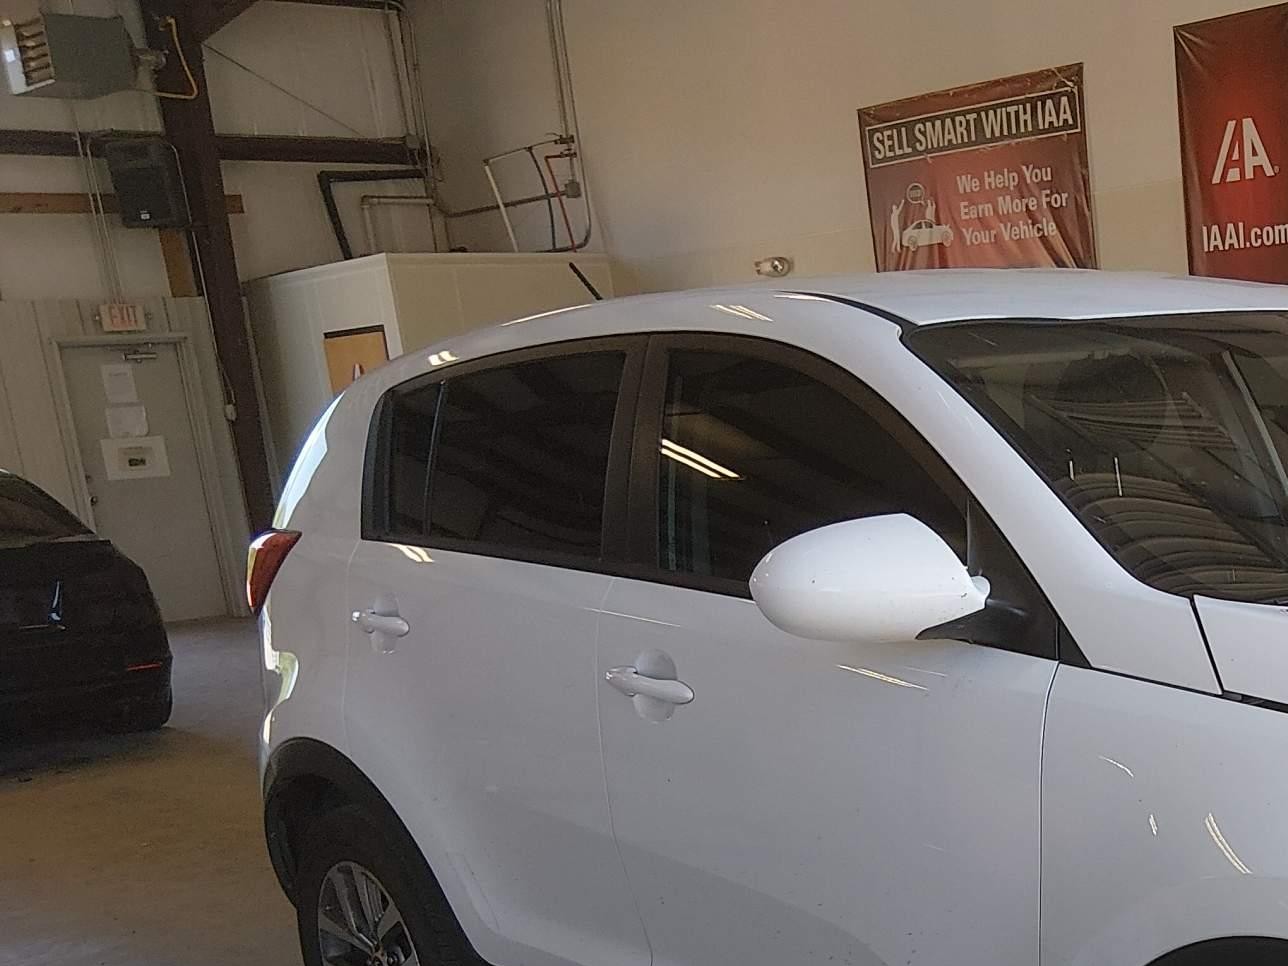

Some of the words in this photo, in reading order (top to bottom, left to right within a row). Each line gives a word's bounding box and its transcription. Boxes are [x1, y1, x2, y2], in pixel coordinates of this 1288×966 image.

[873, 125, 912, 160] SELL
[915, 112, 978, 151] SMART
[981, 103, 1032, 139] WITH
[1037, 96, 1074, 130] IAA
[956, 174, 980, 194] We
[984, 168, 1018, 190] Help
[1021, 164, 1052, 184] You
[960, 201, 994, 220] Earn
[997, 195, 1037, 215] More
[1041, 189, 1068, 208] For
[962, 228, 996, 246] Your
[1000, 218, 1058, 241] Vehicle
